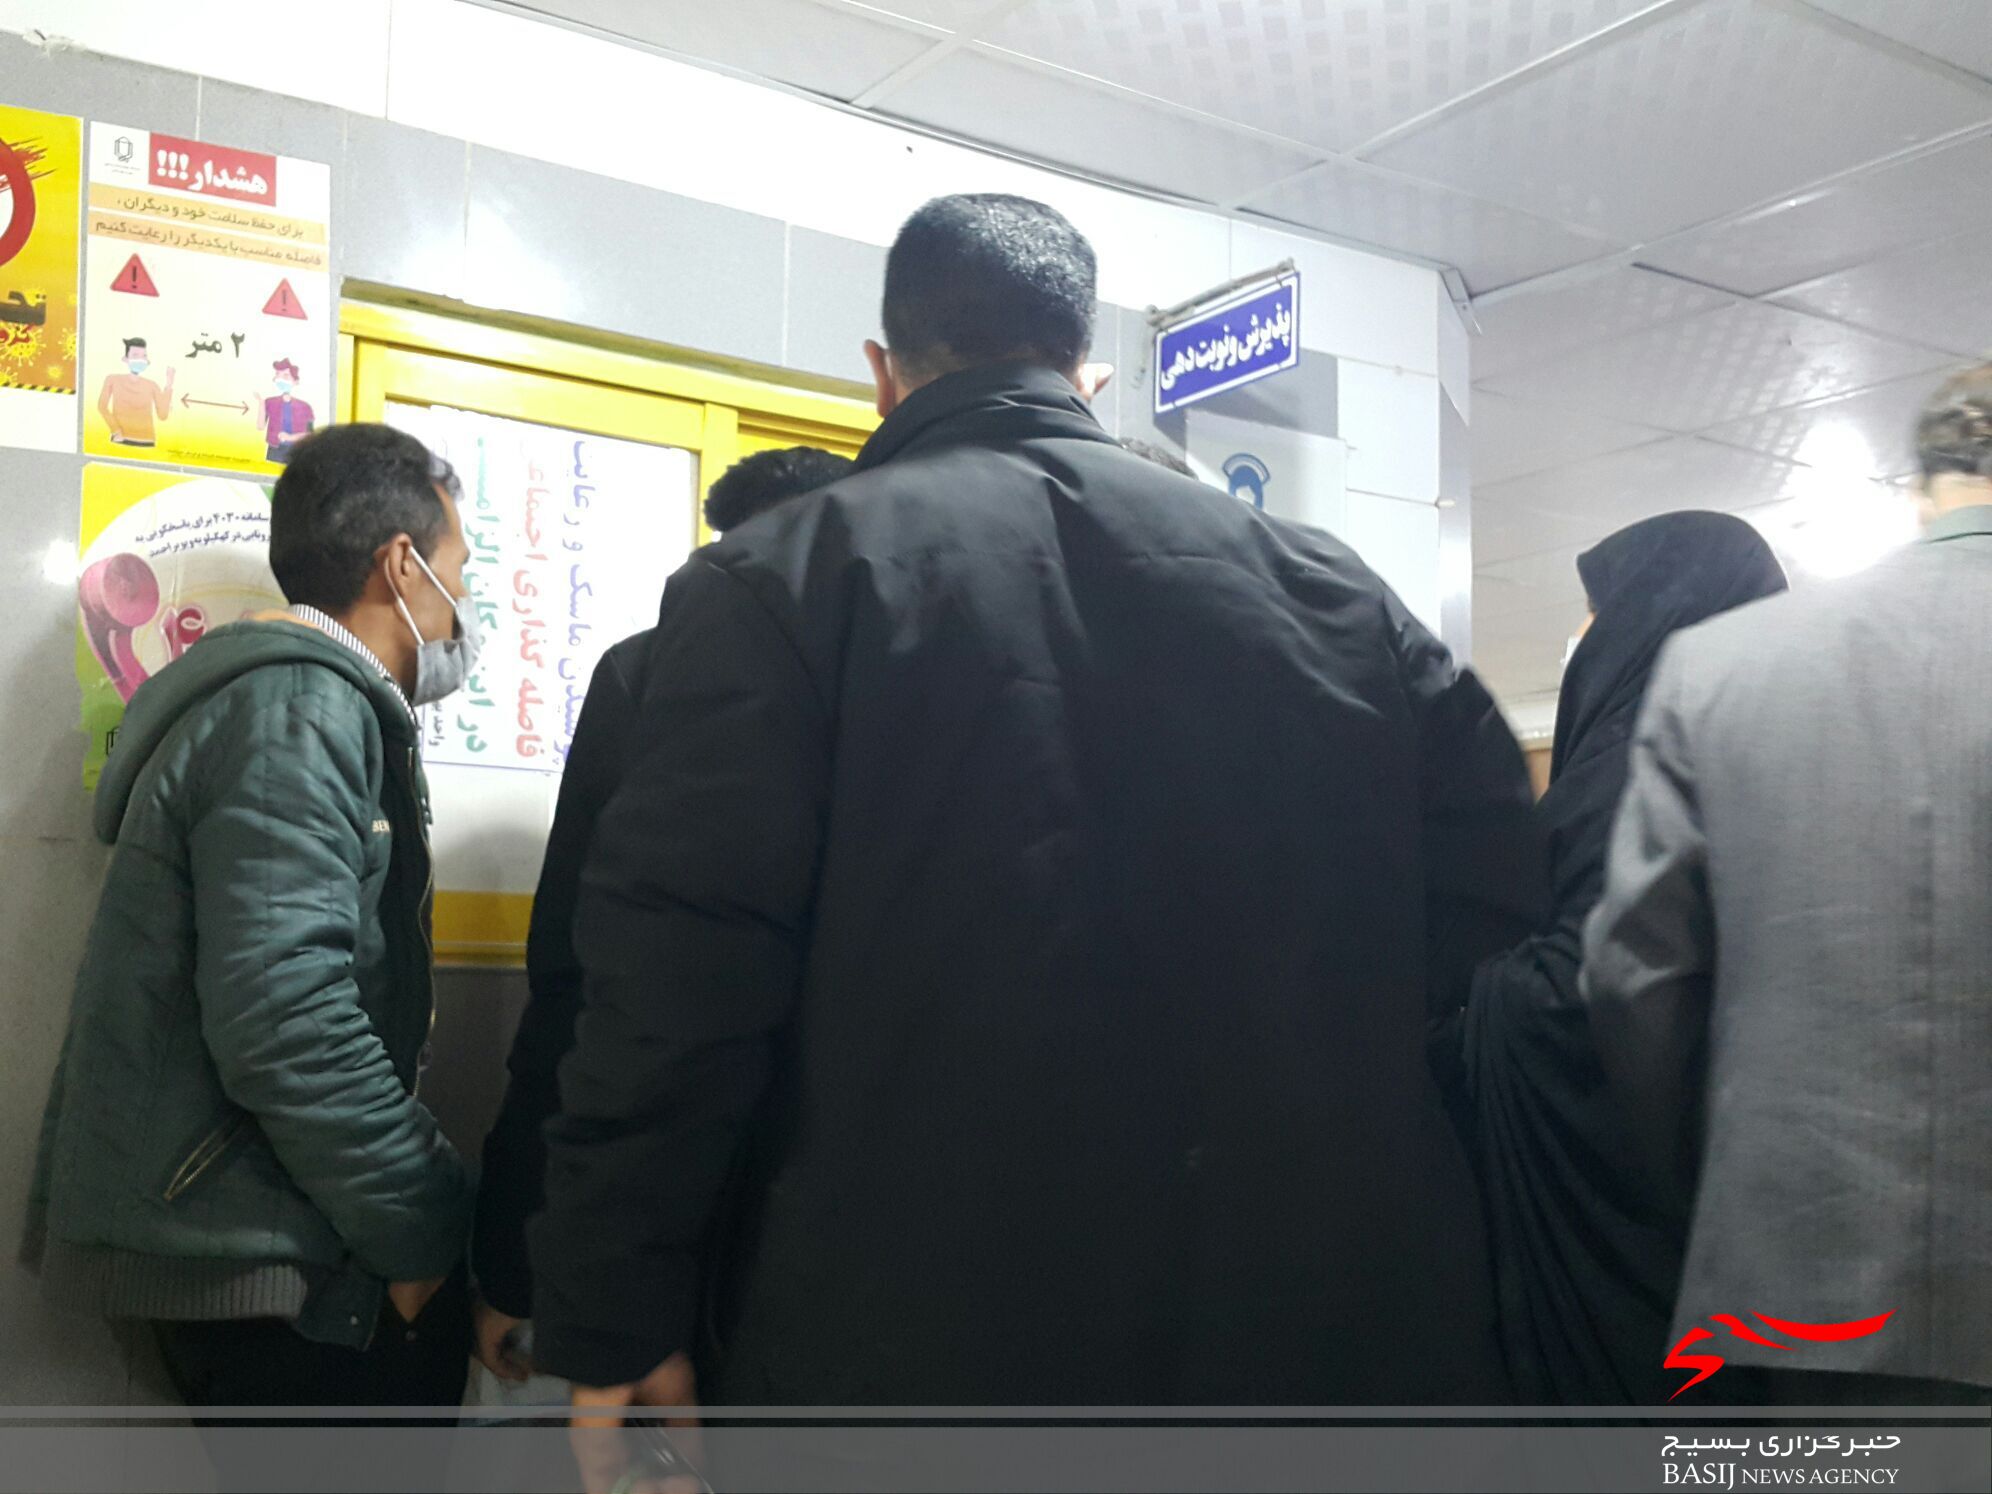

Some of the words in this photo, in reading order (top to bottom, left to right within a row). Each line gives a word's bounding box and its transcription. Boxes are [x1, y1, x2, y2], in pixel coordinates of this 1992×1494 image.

[124, 197, 169, 213] دیگران
[172, 206, 179, 217] و
[181, 207, 206, 220] خود
[96, 221, 127, 235] کنیم
[207, 209, 250, 226] سلامت
[251, 217, 275, 230] حفظ
[277, 223, 304, 239] برای
[286, 250, 322, 266] فاصله
[1238, 302, 1291, 362] پذیرش
[184, 332, 222, 359] متر
[230, 331, 245, 359] ۲
[1195, 323, 1230, 372] نوبت
[1161, 345, 1196, 391] دهی
[563, 440, 596, 526] رعایت
[563, 538, 584, 552] و
[568, 564, 593, 647] ماسک
[516, 677, 545, 758] فاصله
[457, 714, 488, 753] در
